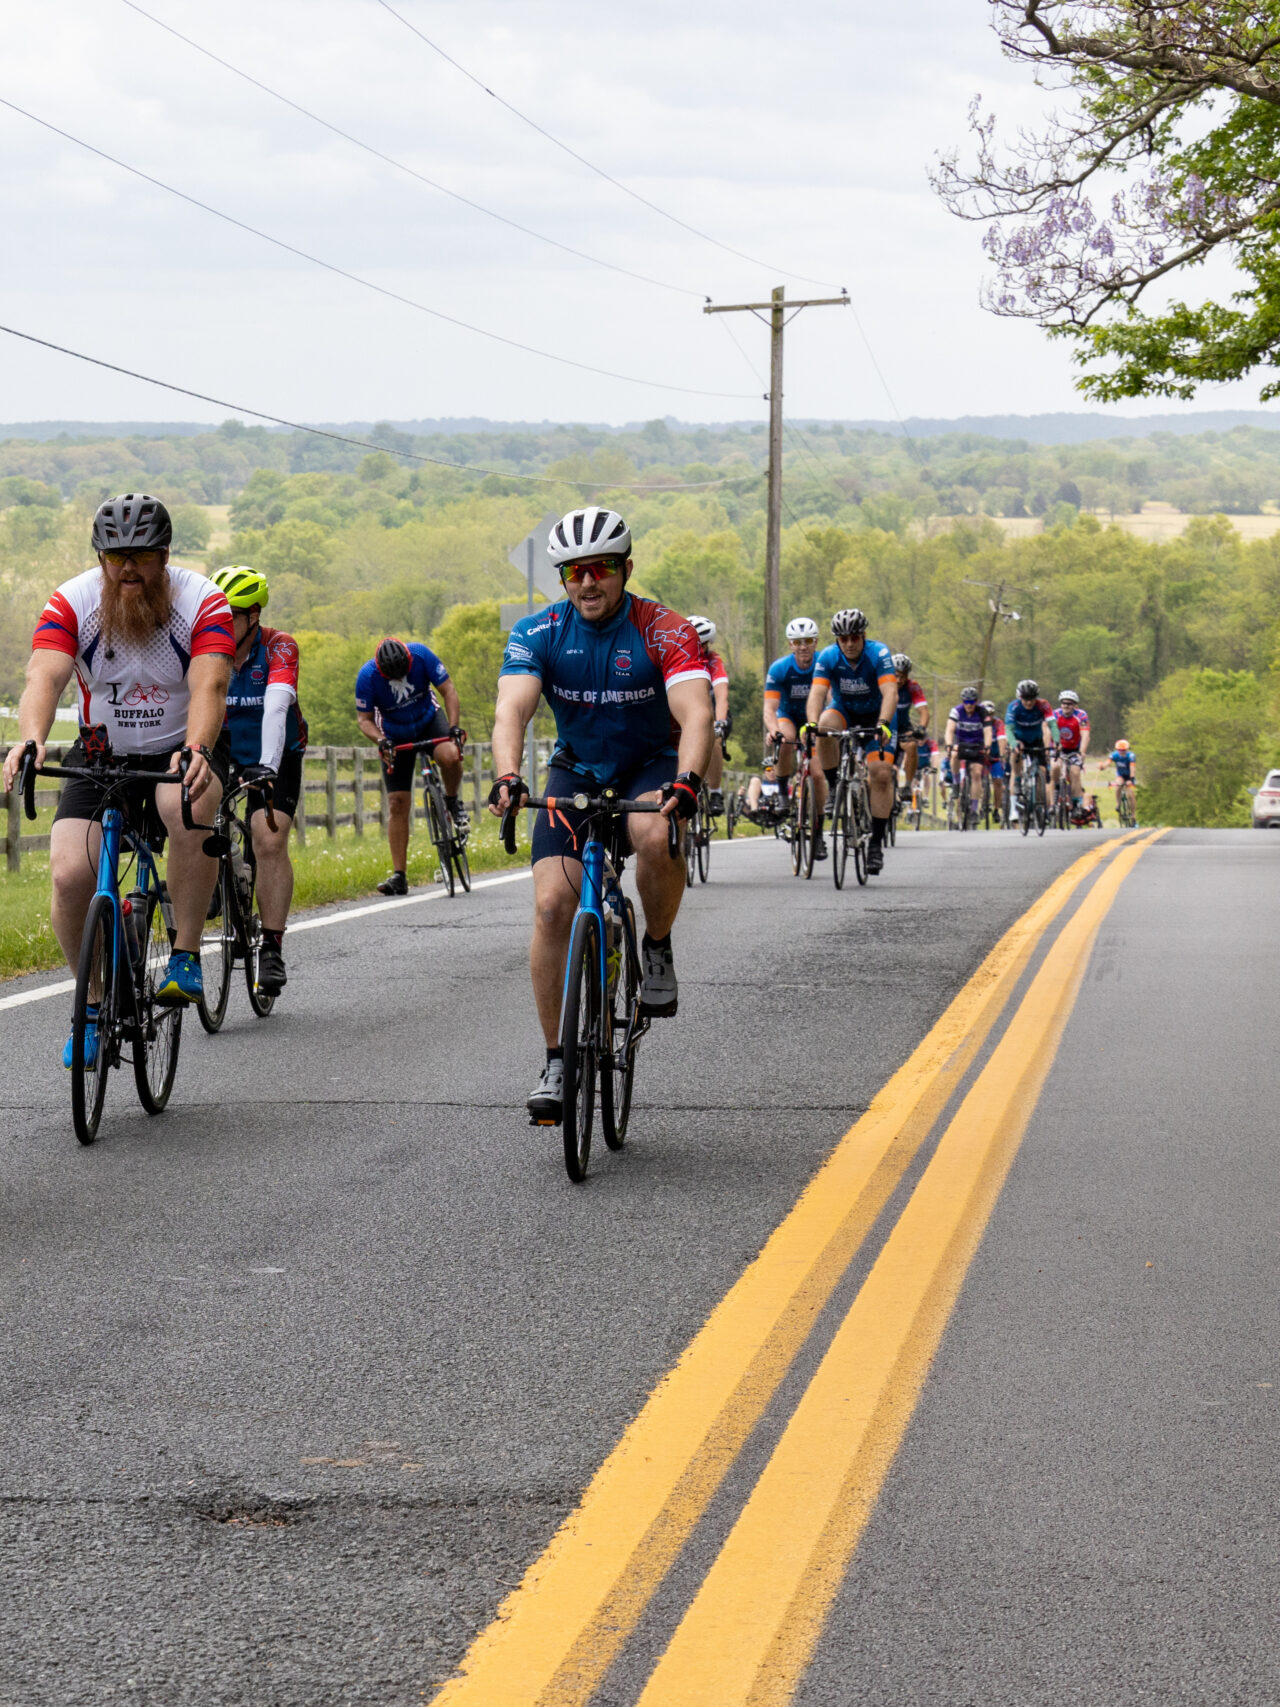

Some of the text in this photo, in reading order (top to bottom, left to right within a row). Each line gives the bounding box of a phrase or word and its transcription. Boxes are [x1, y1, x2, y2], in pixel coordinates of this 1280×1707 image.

[106, 682, 122, 706] I
[552, 684, 656, 704] FACE OF AMERICA
[114, 707, 165, 719] BUFFALO
[118, 719, 161, 729] NEW YORK
